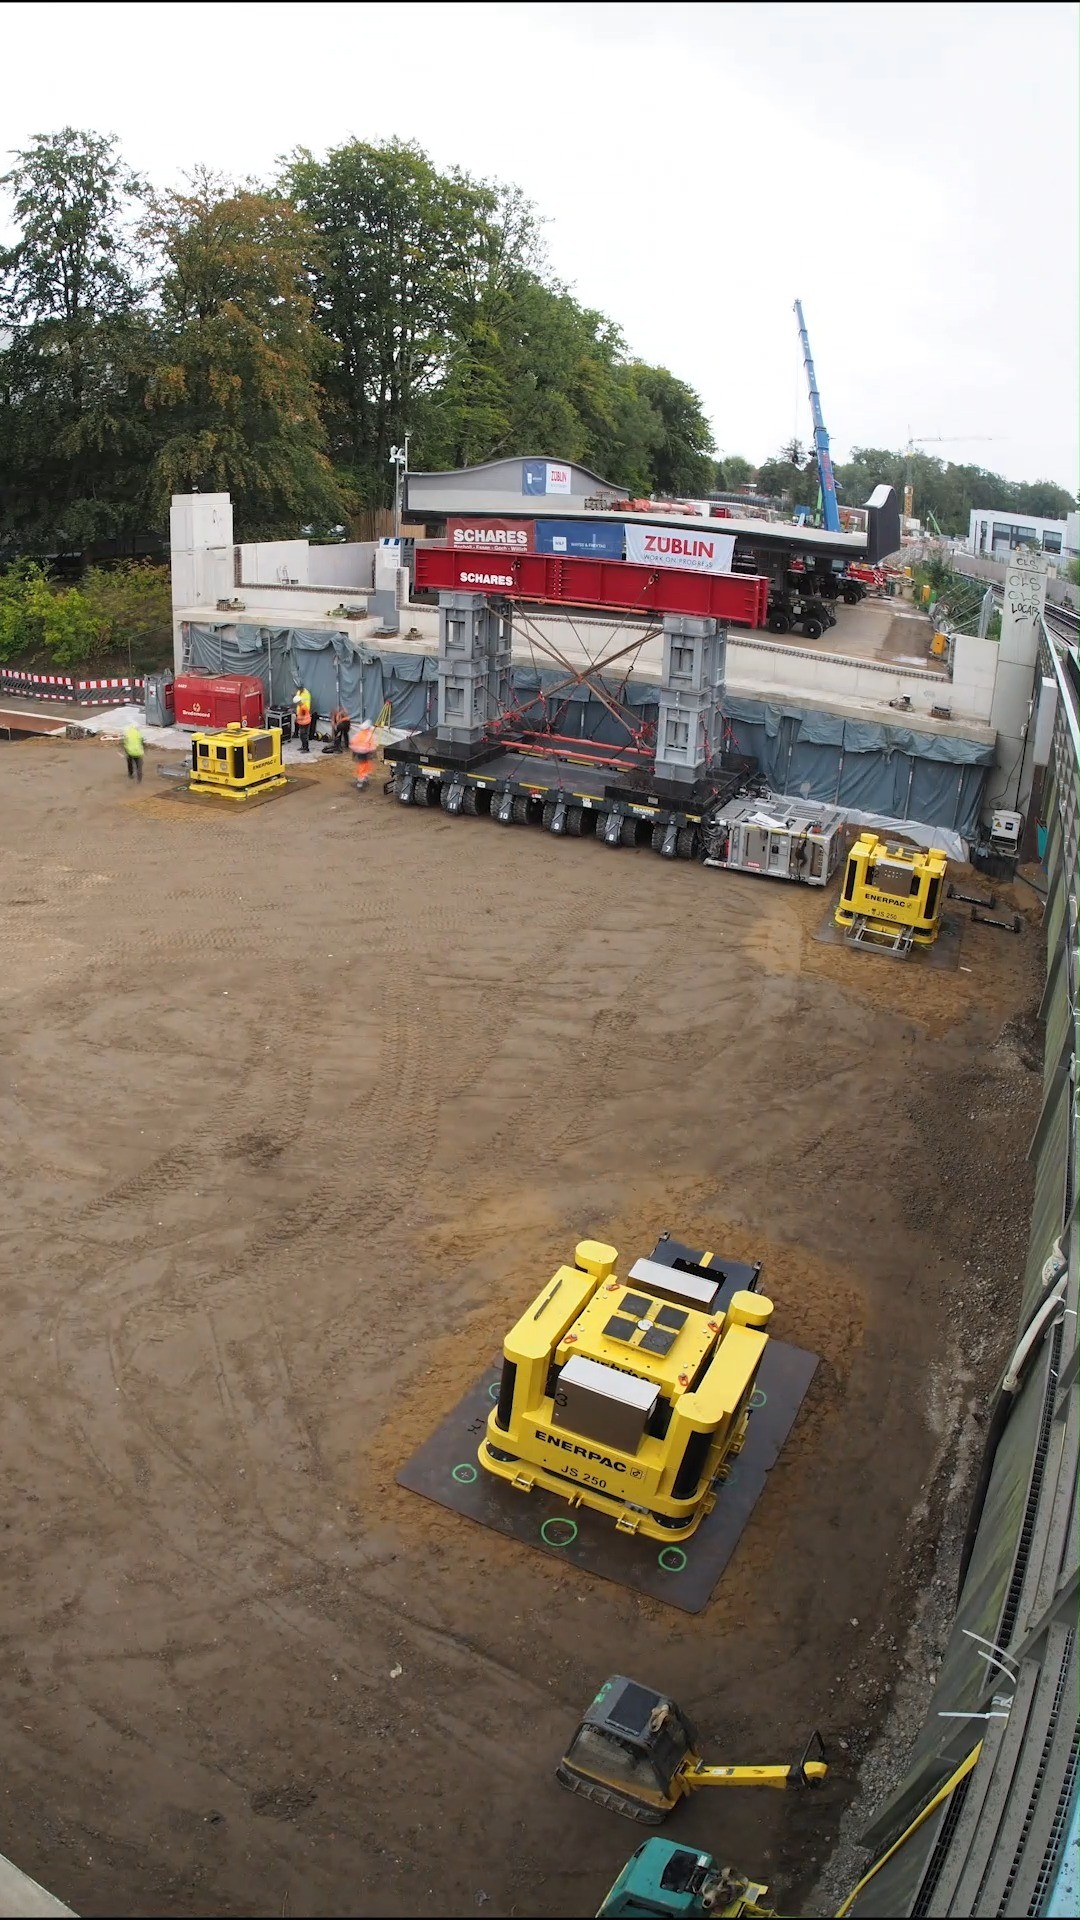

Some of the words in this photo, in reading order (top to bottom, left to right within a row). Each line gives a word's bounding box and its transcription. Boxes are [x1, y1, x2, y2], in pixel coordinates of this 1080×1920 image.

[453, 528, 528, 544] SCHARES
[644, 535, 714, 558] ZÜBLIN
[643, 553, 663, 561] WORK
[1016, 558, 1039, 570] CLS
[459, 571, 514, 587] SCHARES
[1009, 575, 1041, 591] CLS
[1008, 590, 1041, 606] CLS
[500, 812, 508, 820] 10
[874, 870, 880, 878] 2
[865, 893, 906, 908] ENERPAC
[886, 912, 897, 920] 250
[555, 1393, 568, 1407] 3
[535, 1429, 627, 1473] ENERPAC
[561, 1465, 579, 1478] JS
[582, 1472, 607, 1490] 250
